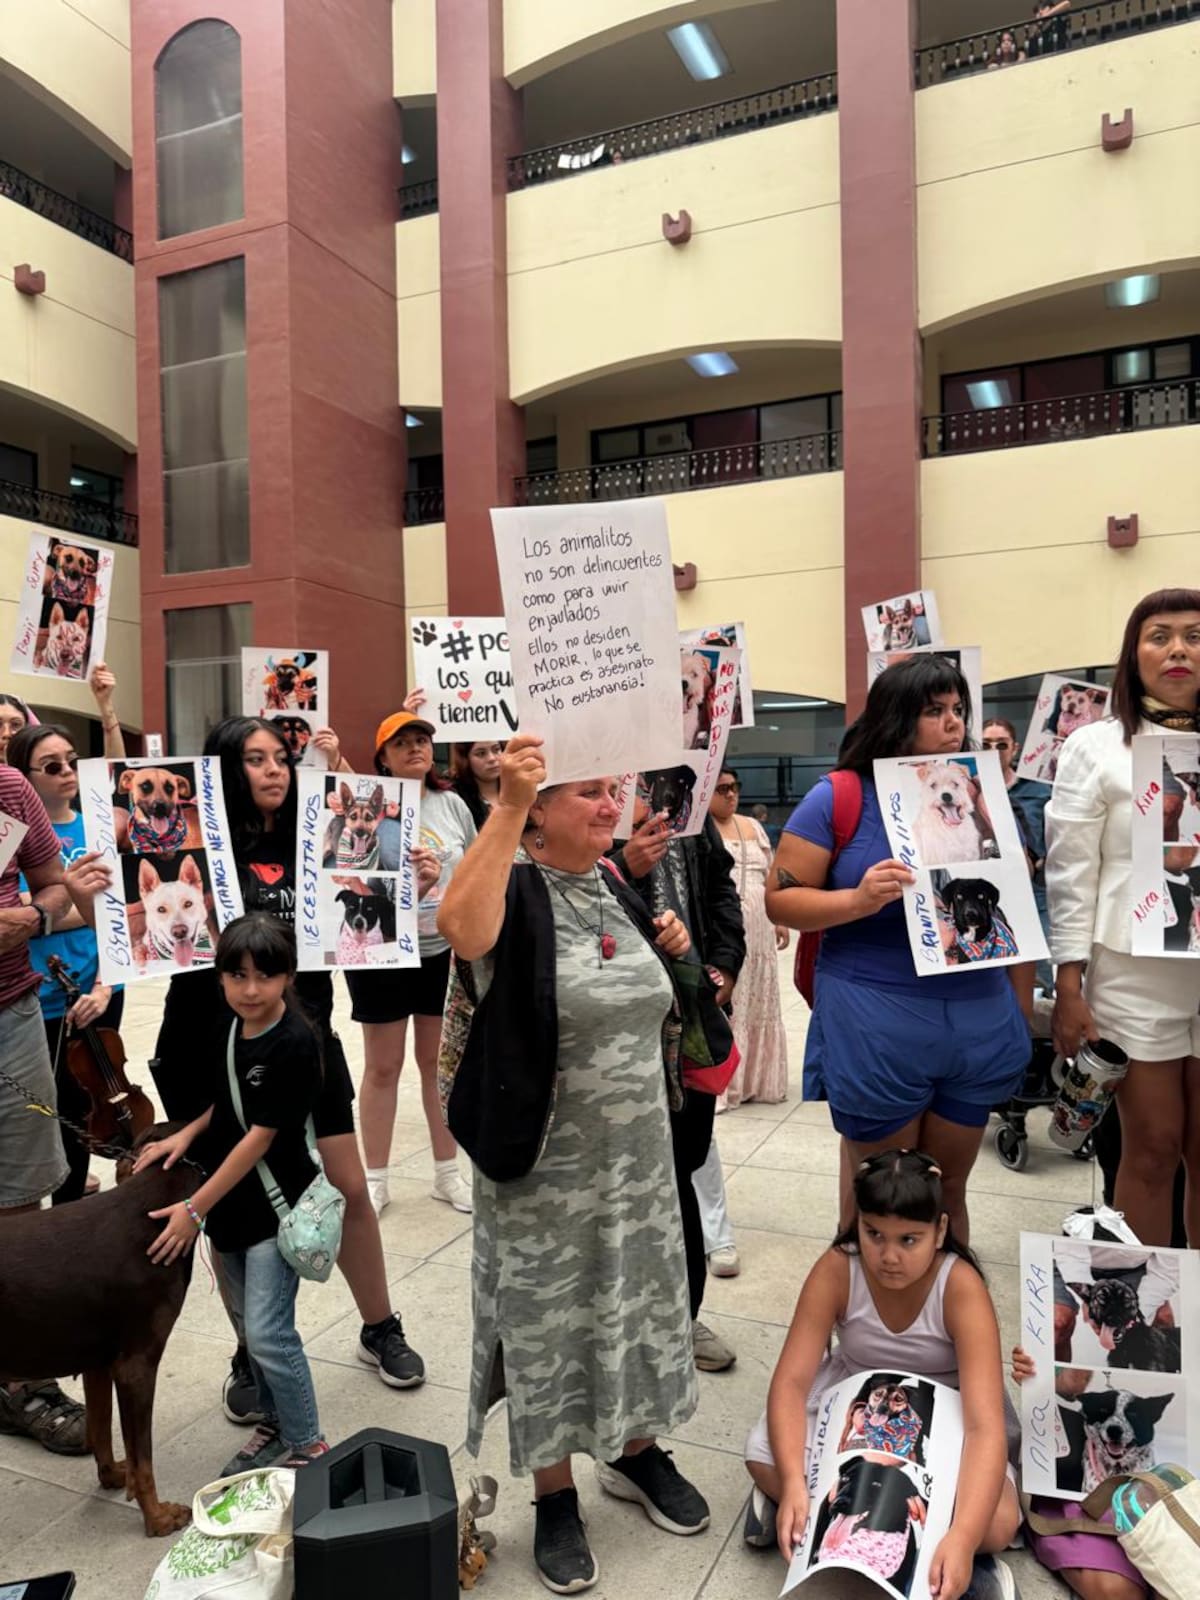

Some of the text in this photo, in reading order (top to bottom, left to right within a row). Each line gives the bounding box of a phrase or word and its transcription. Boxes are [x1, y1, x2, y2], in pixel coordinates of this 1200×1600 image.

[523, 525, 633, 559] Los animalitos
[525, 550, 663, 584] no son delincuentes
[522, 592, 555, 608] como
[564, 585, 594, 606] para
[528, 603, 601, 632] enjaulados
[528, 626, 631, 656] Ellos no desiden
[592, 648, 602, 661] lo
[605, 648, 625, 665] que
[626, 642, 642, 653] se
[437, 667, 514, 695] los qu
[528, 654, 654, 698] practica es asesinato
[438, 702, 498, 724] tienen
[544, 694, 565, 713] No
[1133, 890, 1160, 924] Nica
[1025, 1262, 1049, 1346] KIRA
